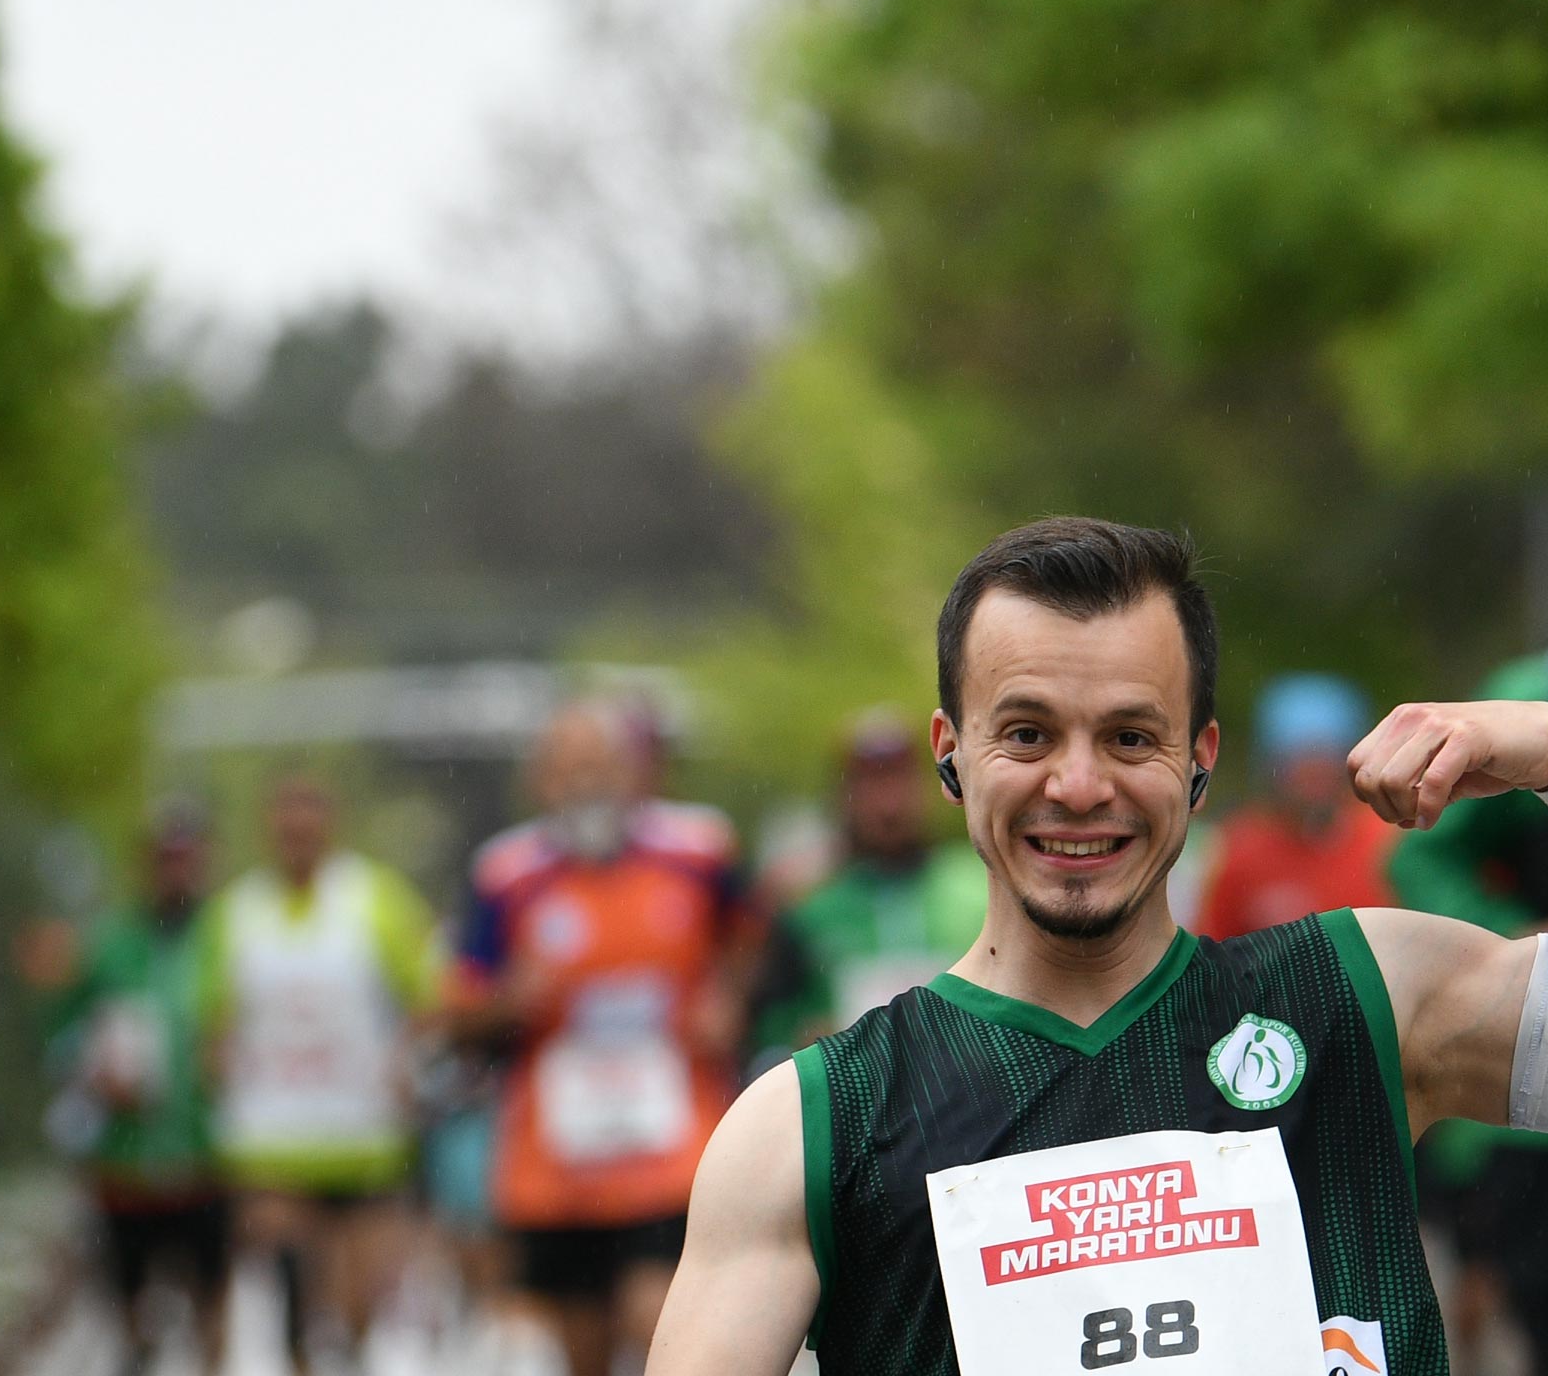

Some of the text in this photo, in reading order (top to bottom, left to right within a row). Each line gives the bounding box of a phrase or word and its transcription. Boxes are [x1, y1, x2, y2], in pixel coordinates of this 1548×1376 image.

[1241, 1098, 1281, 1110] 2005
[1040, 1168, 1183, 1214] KONYA
[1065, 1198, 1164, 1235] YARI
[999, 1216, 1241, 1276] MARATONU
[1080, 1299, 1200, 1371] 88
